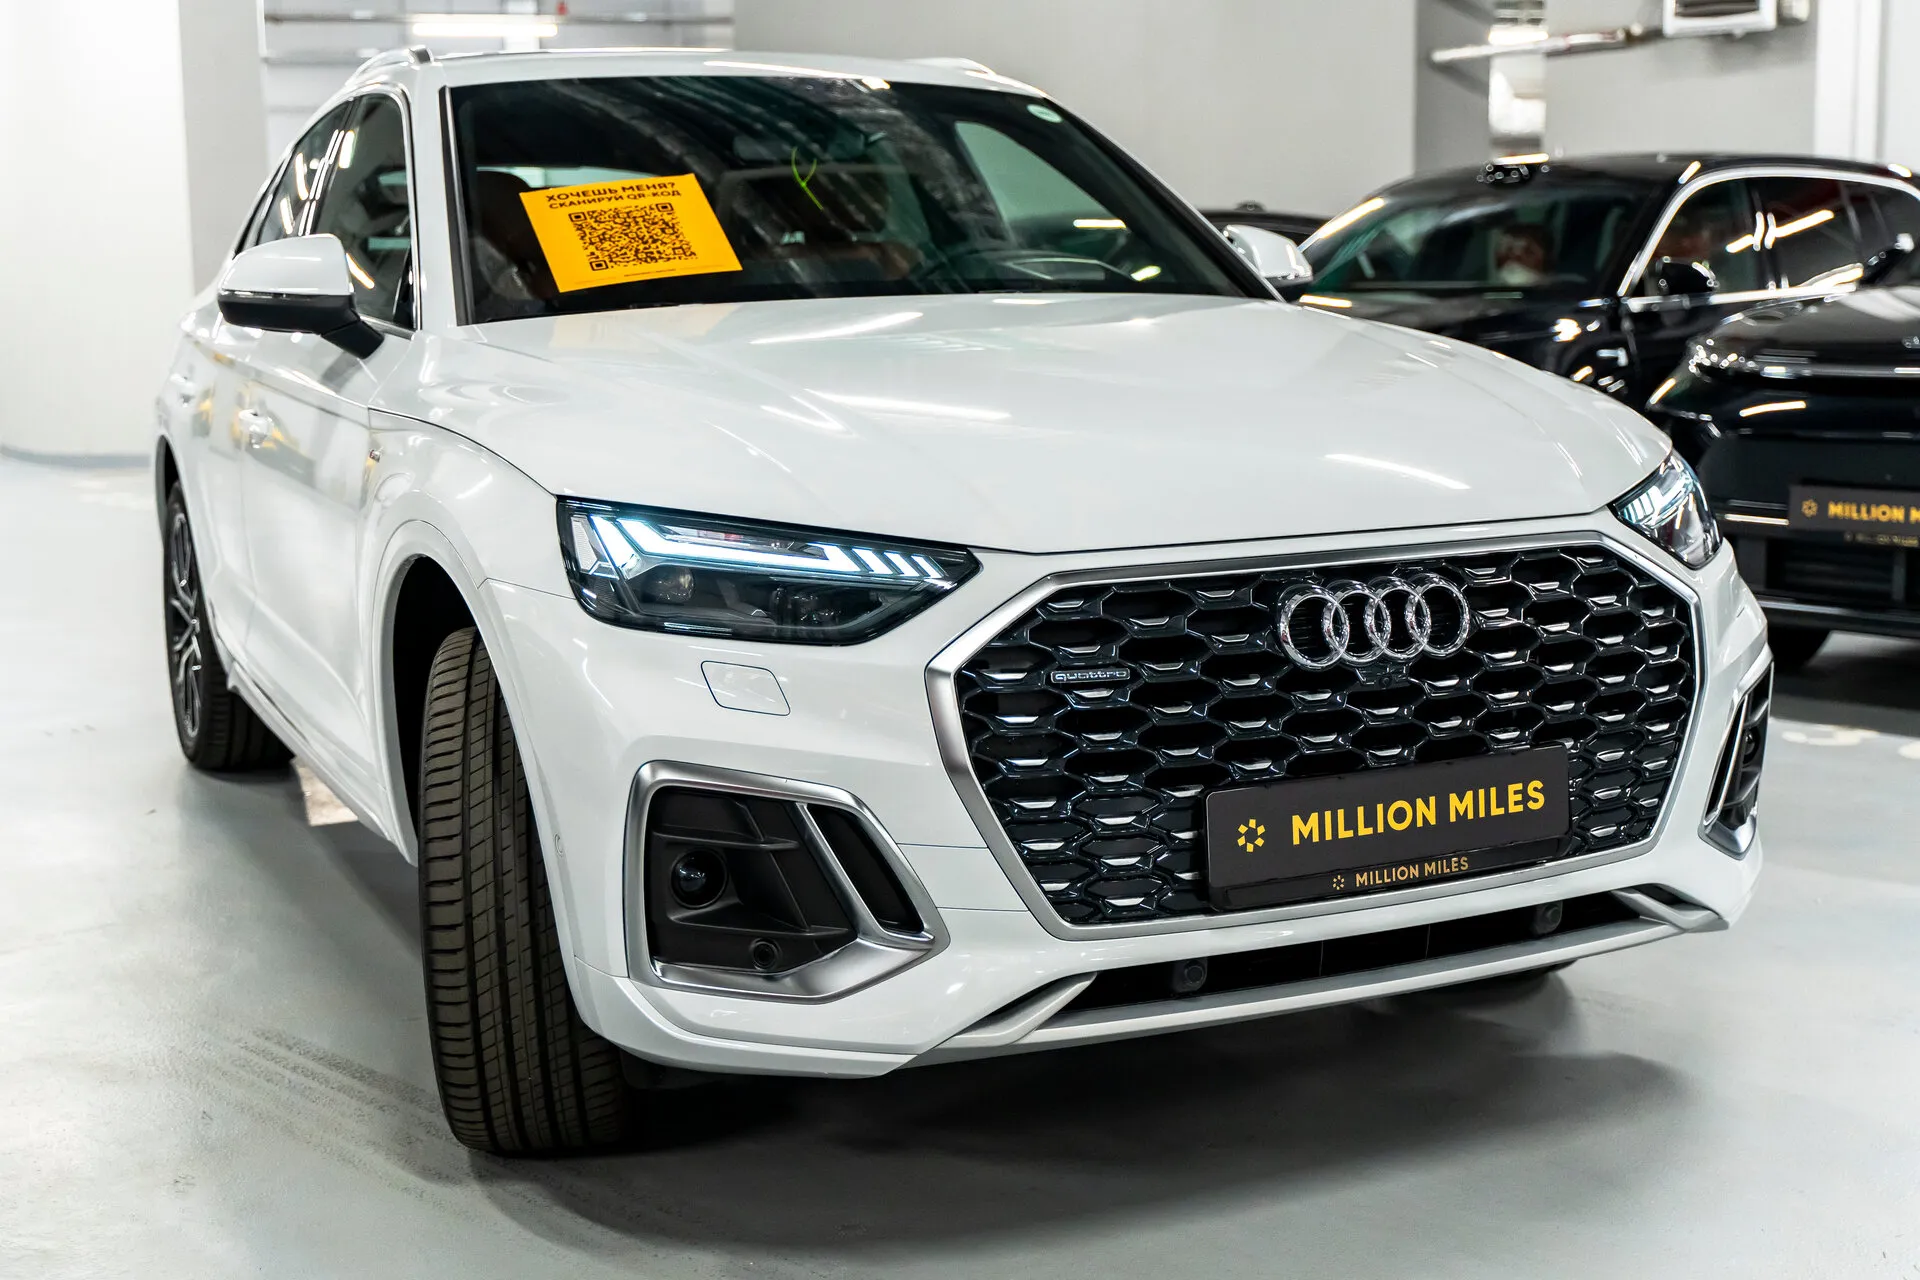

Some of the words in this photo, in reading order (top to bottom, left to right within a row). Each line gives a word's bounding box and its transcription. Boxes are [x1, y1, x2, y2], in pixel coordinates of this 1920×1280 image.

[546, 187, 618, 203] ХОЧЕШЬ
[621, 181, 676, 194] МЕНЯ?
[549, 194, 624, 209] СКАНИРУЙ
[1828, 501, 1905, 523] MILLION
[1055, 670, 1127, 682] quattro
[1292, 795, 1437, 845] MILLION
[1449, 780, 1545, 823] MILES
[1355, 863, 1420, 887] MILLION
[1424, 856, 1469, 877] MILES
